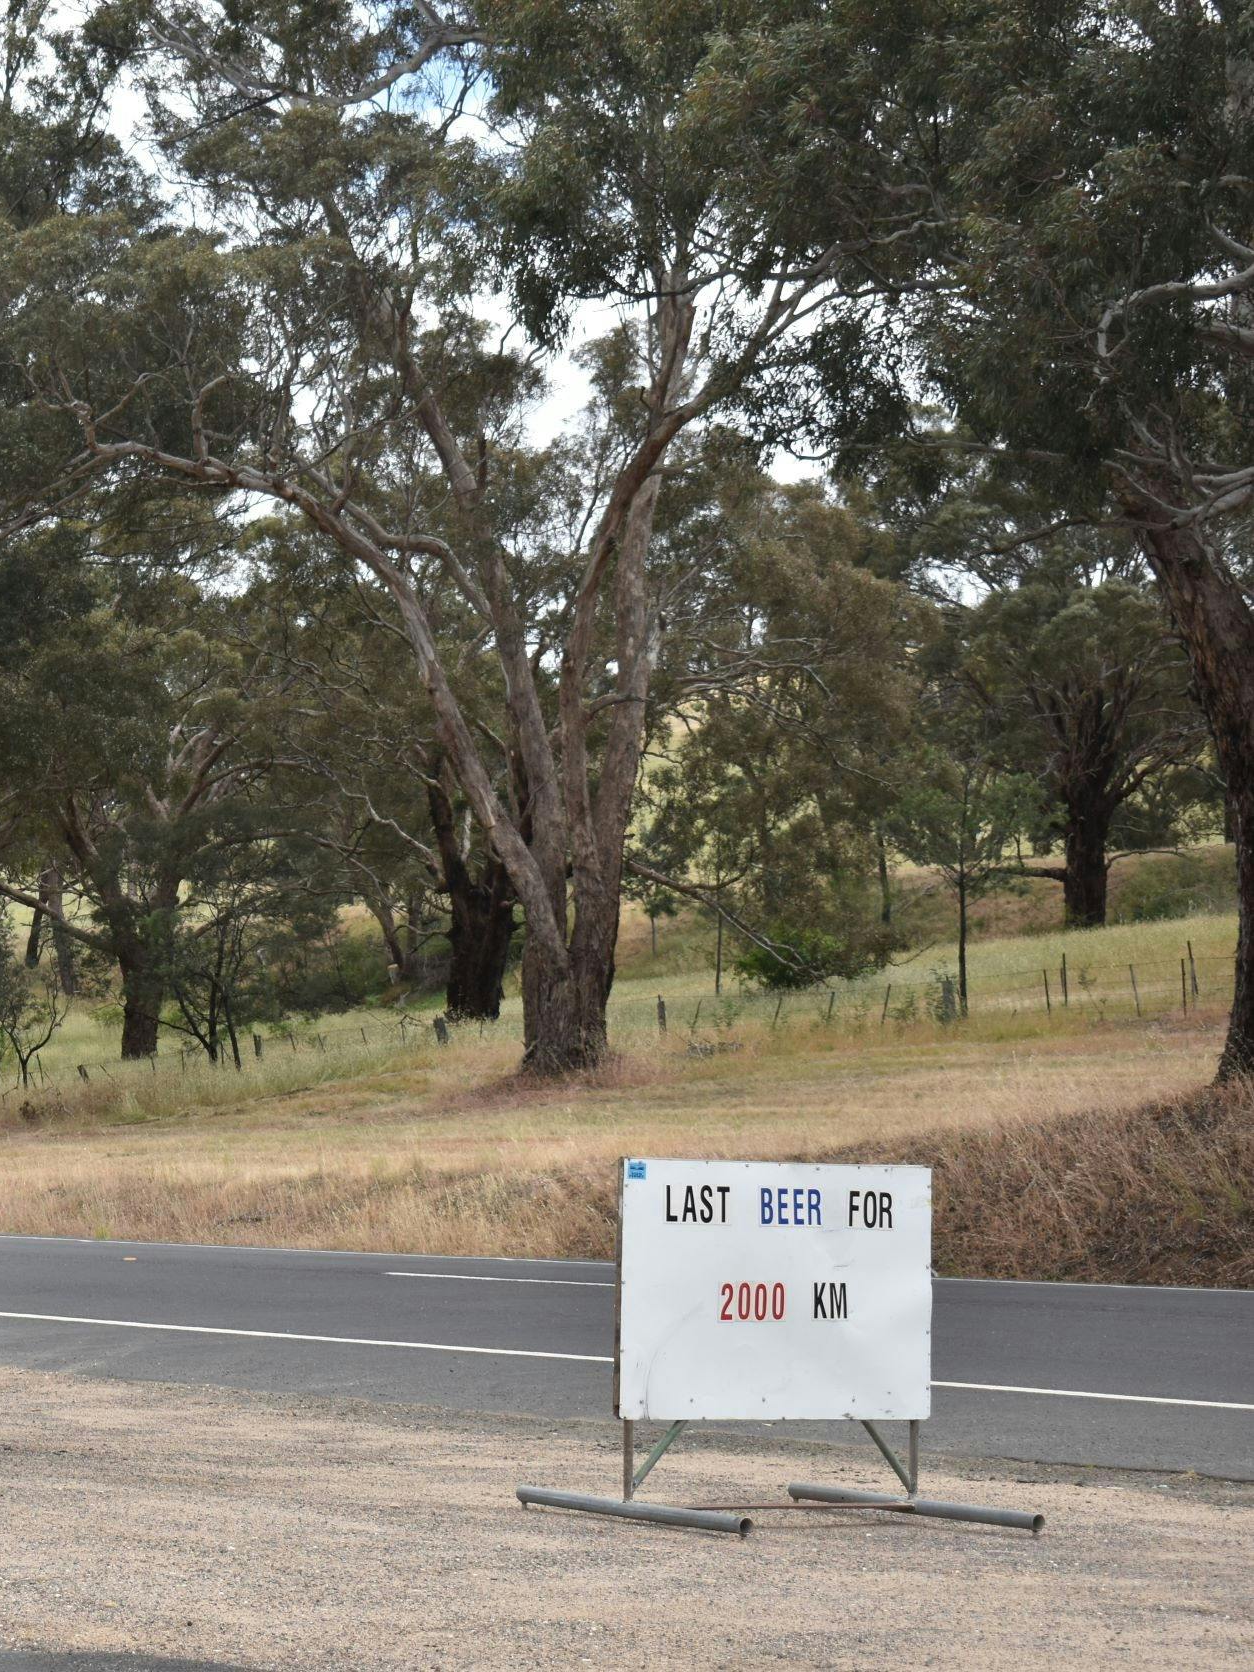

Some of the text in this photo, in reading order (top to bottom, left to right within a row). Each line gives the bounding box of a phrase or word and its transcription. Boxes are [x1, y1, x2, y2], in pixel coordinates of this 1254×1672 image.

[665, 1184, 893, 1229] LAST BEER FOR
[719, 1281, 848, 1321] 2000 KM
